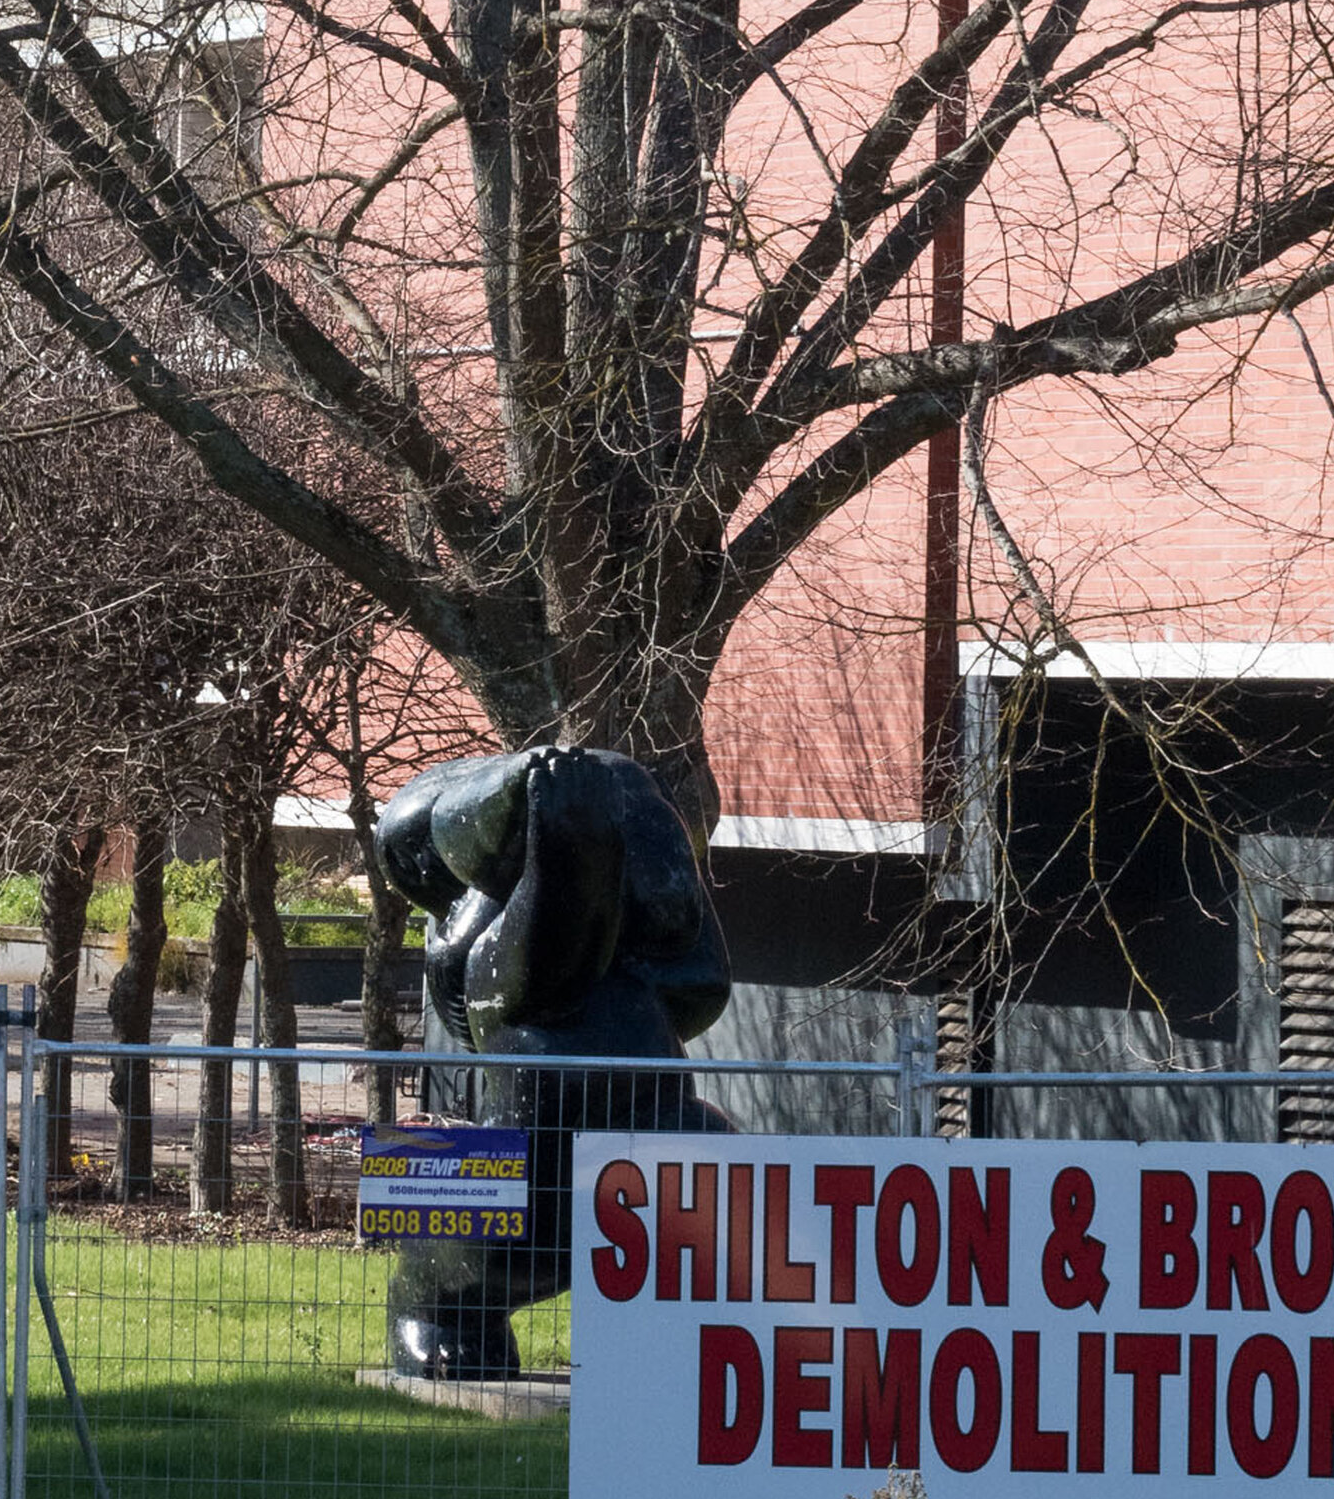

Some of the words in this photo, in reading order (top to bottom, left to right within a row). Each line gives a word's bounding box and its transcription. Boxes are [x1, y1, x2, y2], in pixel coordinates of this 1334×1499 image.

[362, 1157, 525, 1178] 0508TEMPFENCE
[388, 1186, 498, 1197] 0508tempfence.co.nz
[362, 1209, 420, 1235] 0508
[428, 1211, 472, 1236] 836
[480, 1212, 524, 1237] 733
[591, 1158, 1011, 1307] SHILTON
[1042, 1166, 1109, 1314] &
